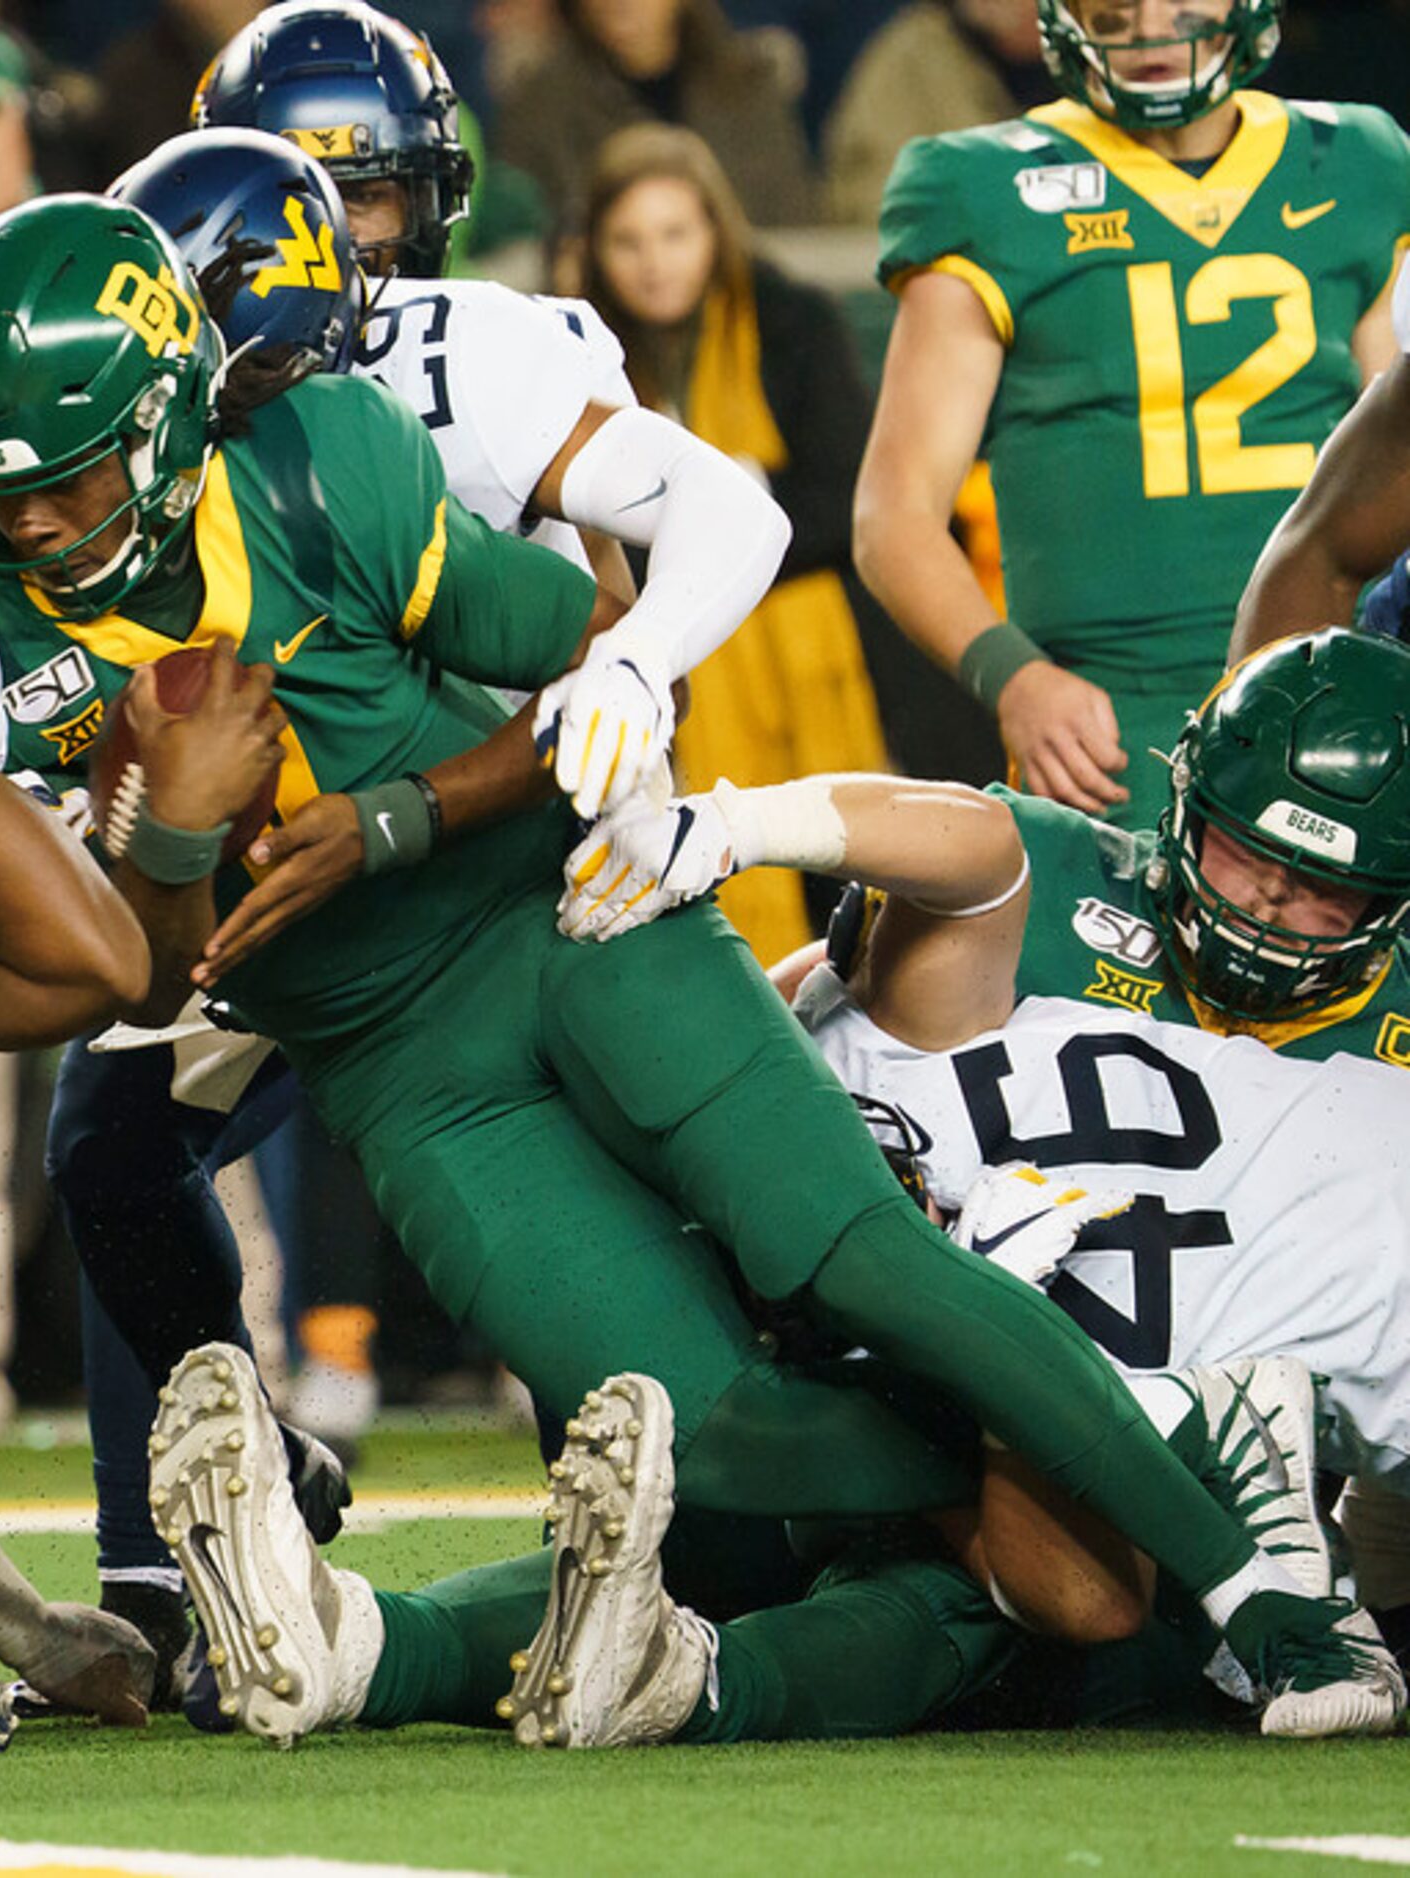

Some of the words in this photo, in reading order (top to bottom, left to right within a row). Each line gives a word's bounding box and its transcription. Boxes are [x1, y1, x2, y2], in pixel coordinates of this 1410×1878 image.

[1127, 253, 1317, 499] 12
[3, 647, 94, 721] 150
[1285, 806, 1339, 844] BEARS
[1072, 897, 1162, 967] 150
[951, 1032, 1235, 1369] 46
